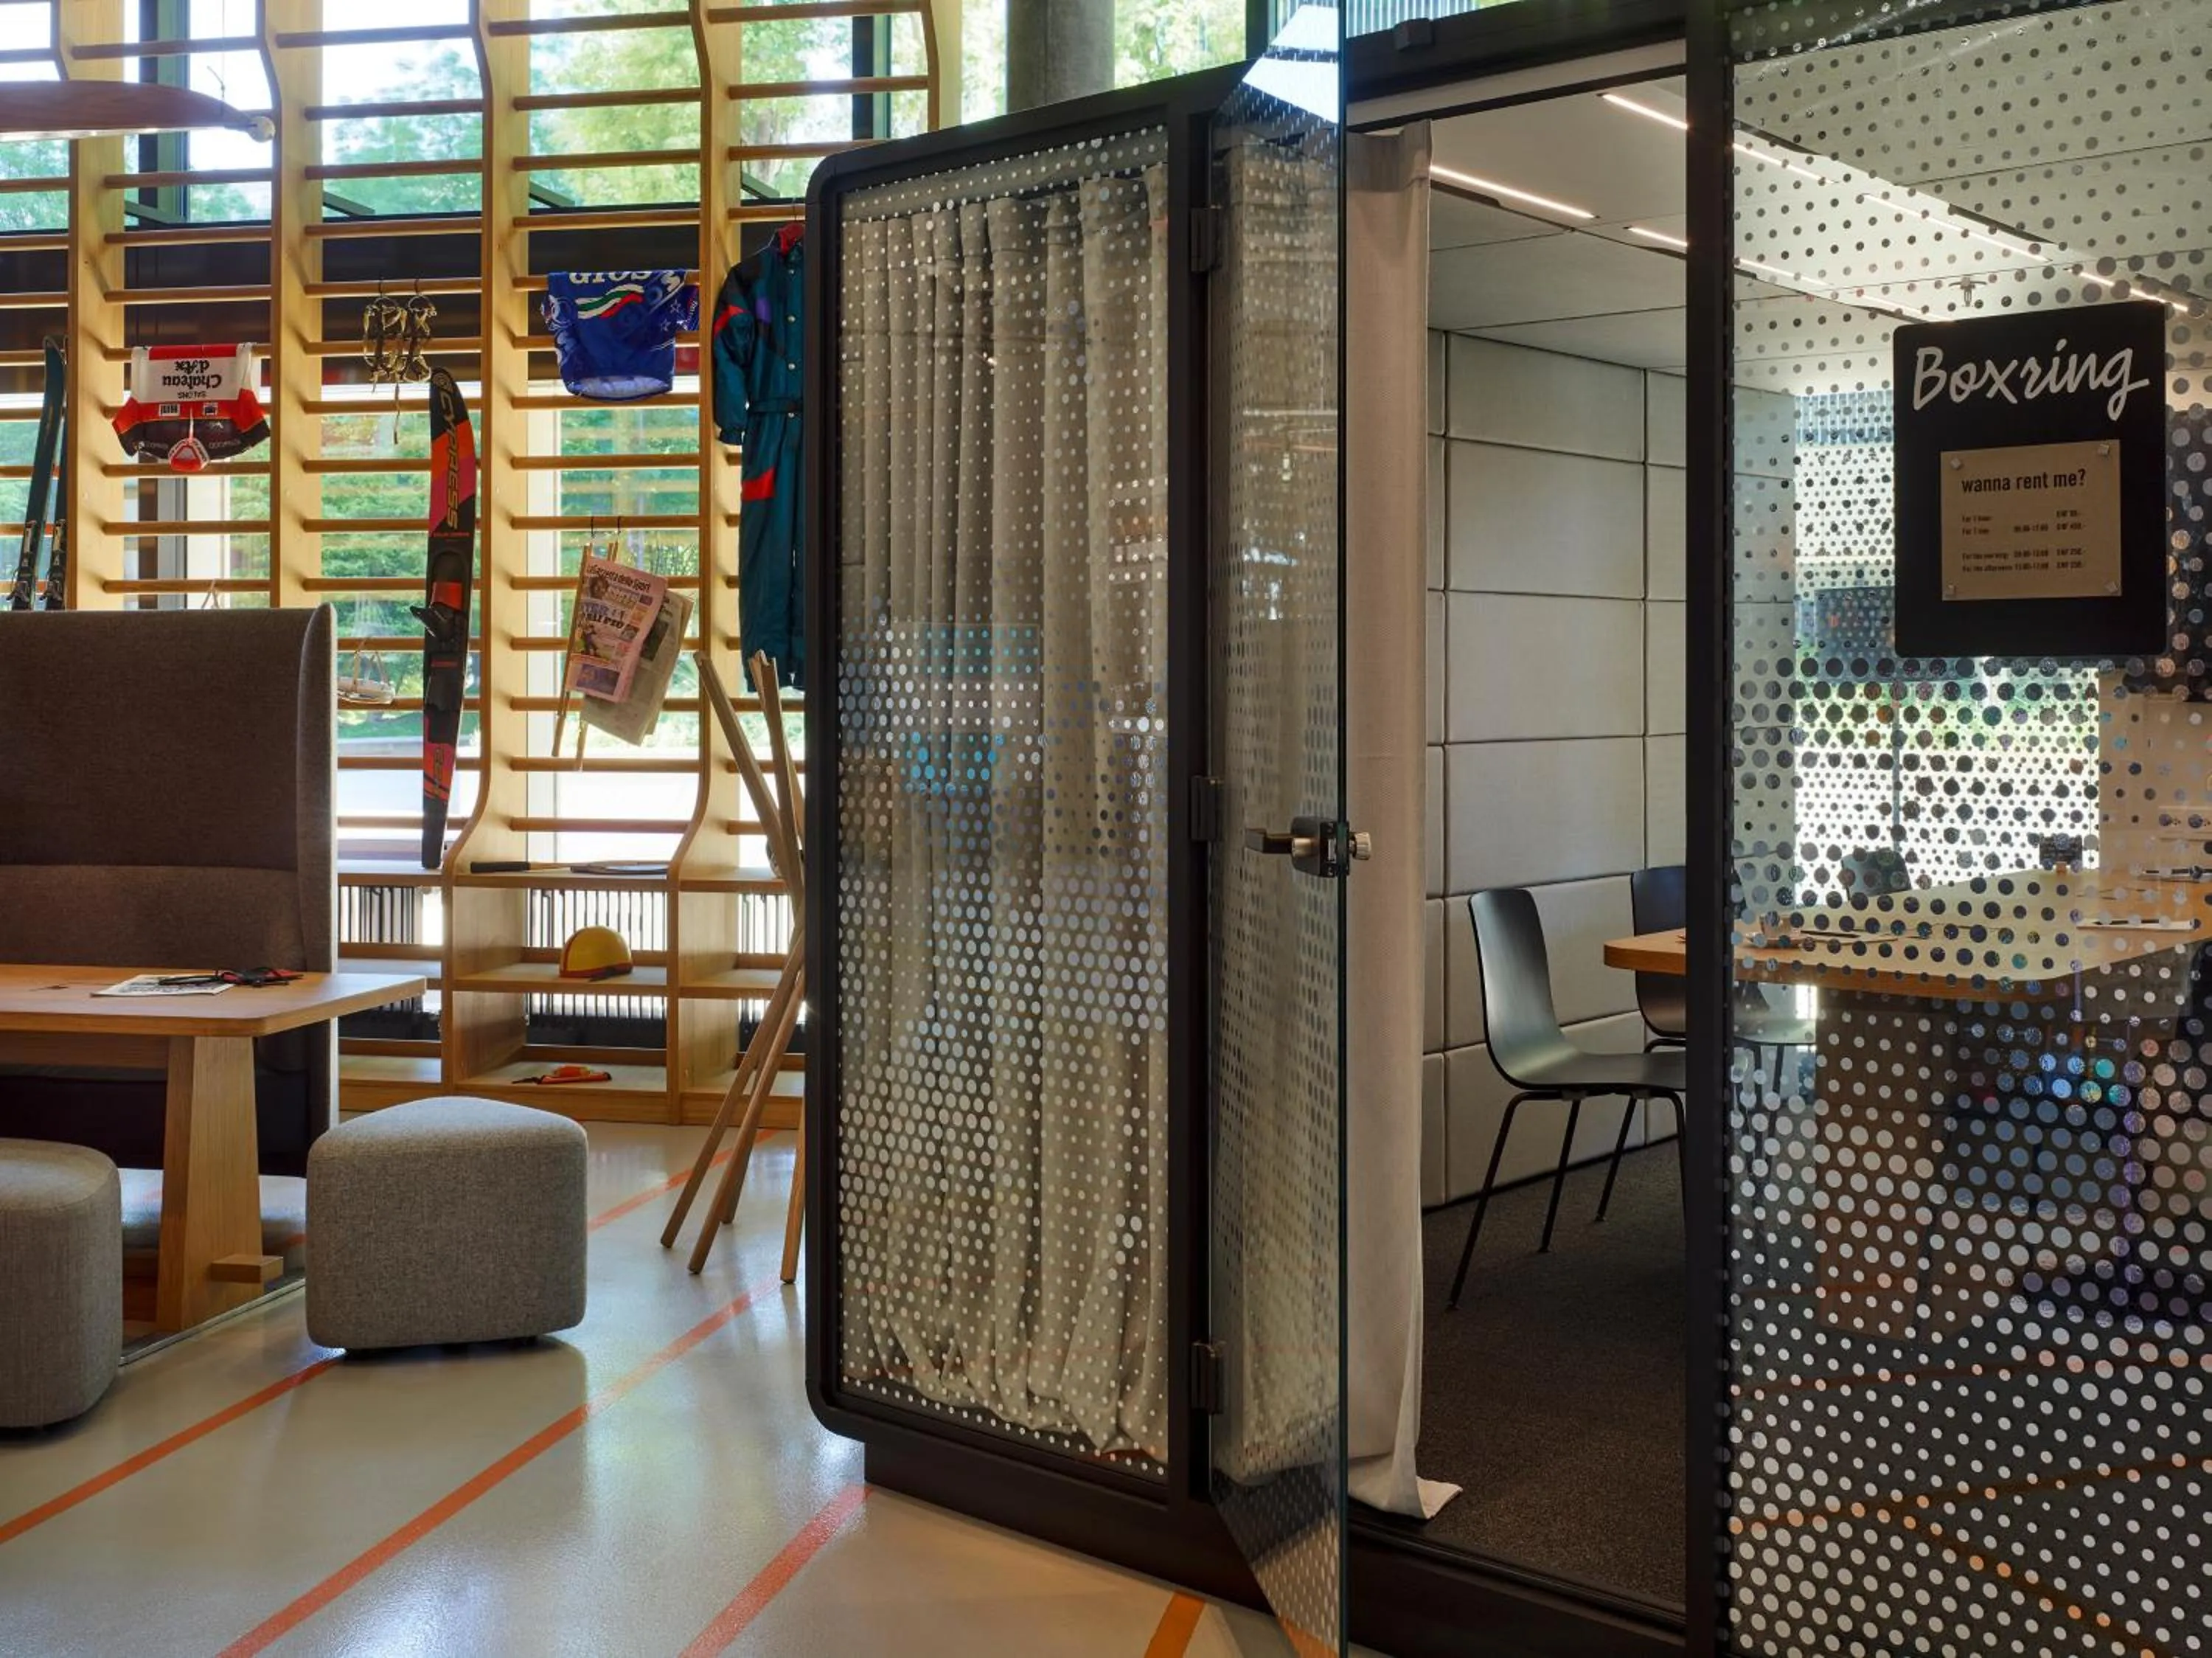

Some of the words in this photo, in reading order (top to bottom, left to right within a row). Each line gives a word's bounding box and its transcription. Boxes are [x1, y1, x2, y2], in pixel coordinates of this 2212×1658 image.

[162, 374, 222, 389] Chateau
[1913, 339, 2150, 421] Boxring
[439, 391, 459, 530] CYPRESS
[1961, 476, 2011, 493] wanna
[2016, 471, 2048, 490] rent
[2053, 468, 2087, 488] me?
